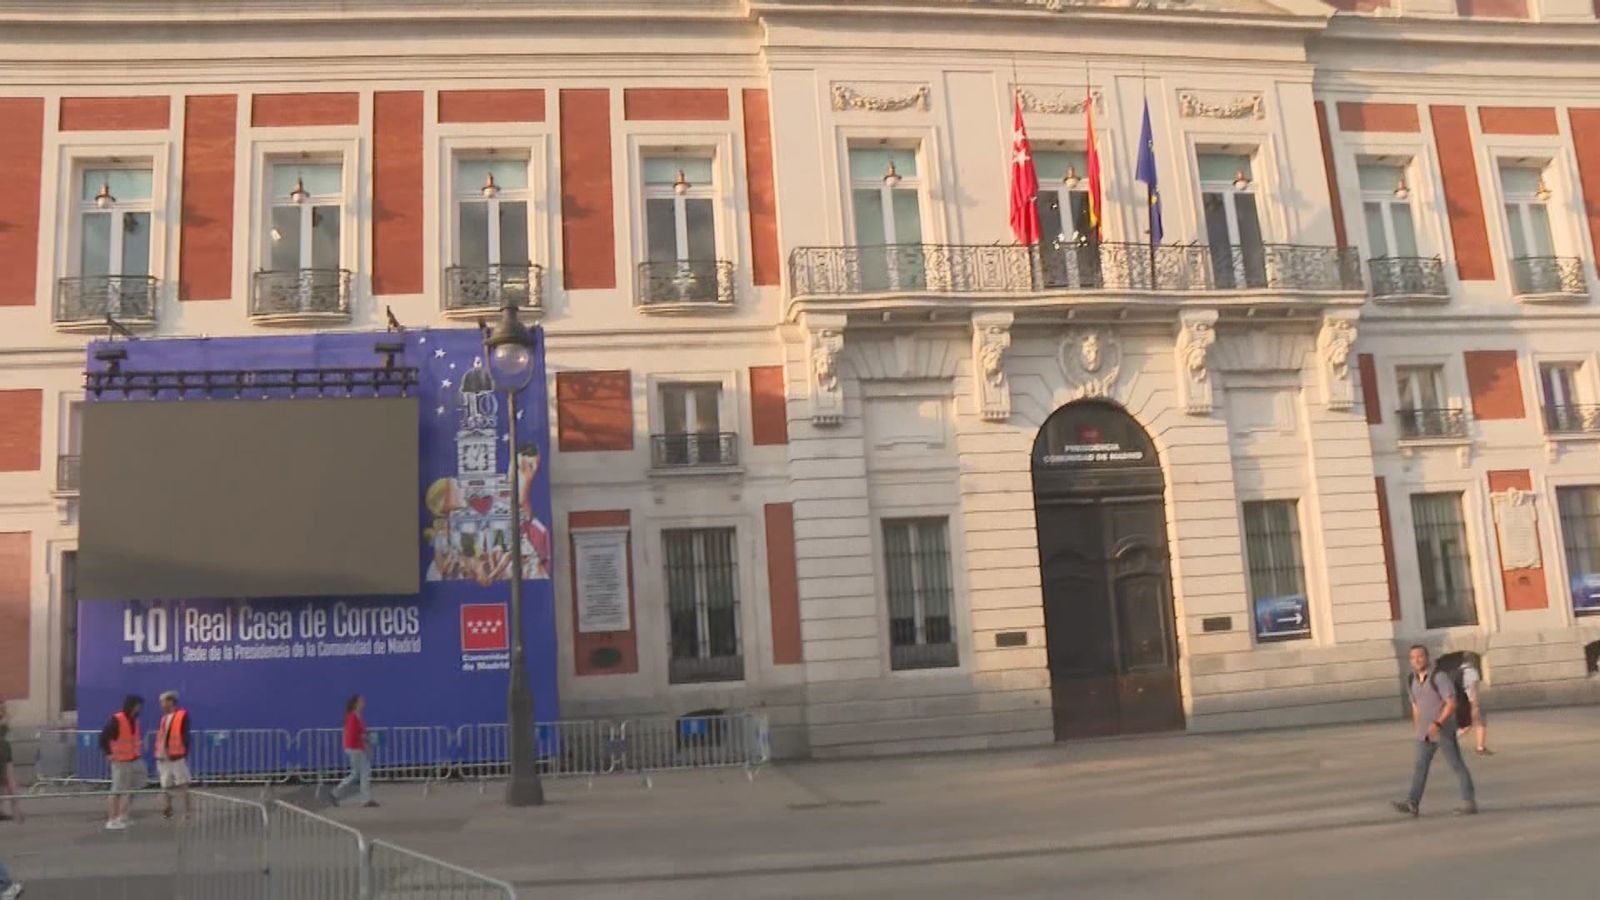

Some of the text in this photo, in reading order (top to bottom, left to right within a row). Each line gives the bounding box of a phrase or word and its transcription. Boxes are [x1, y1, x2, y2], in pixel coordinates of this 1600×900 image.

[1064, 443, 1120, 452] PRESIDENCIA
[1043, 451, 1143, 464] COMUNIDAD DE MADRID
[185, 601, 420, 643] Real Casa de Correos
[123, 607, 167, 653] 40
[183, 636, 422, 662] Sede de la Presidencia de la Comunidad de Madrid
[462, 652, 510, 661] Comunidad
[462, 661, 510, 671] de Madrid
